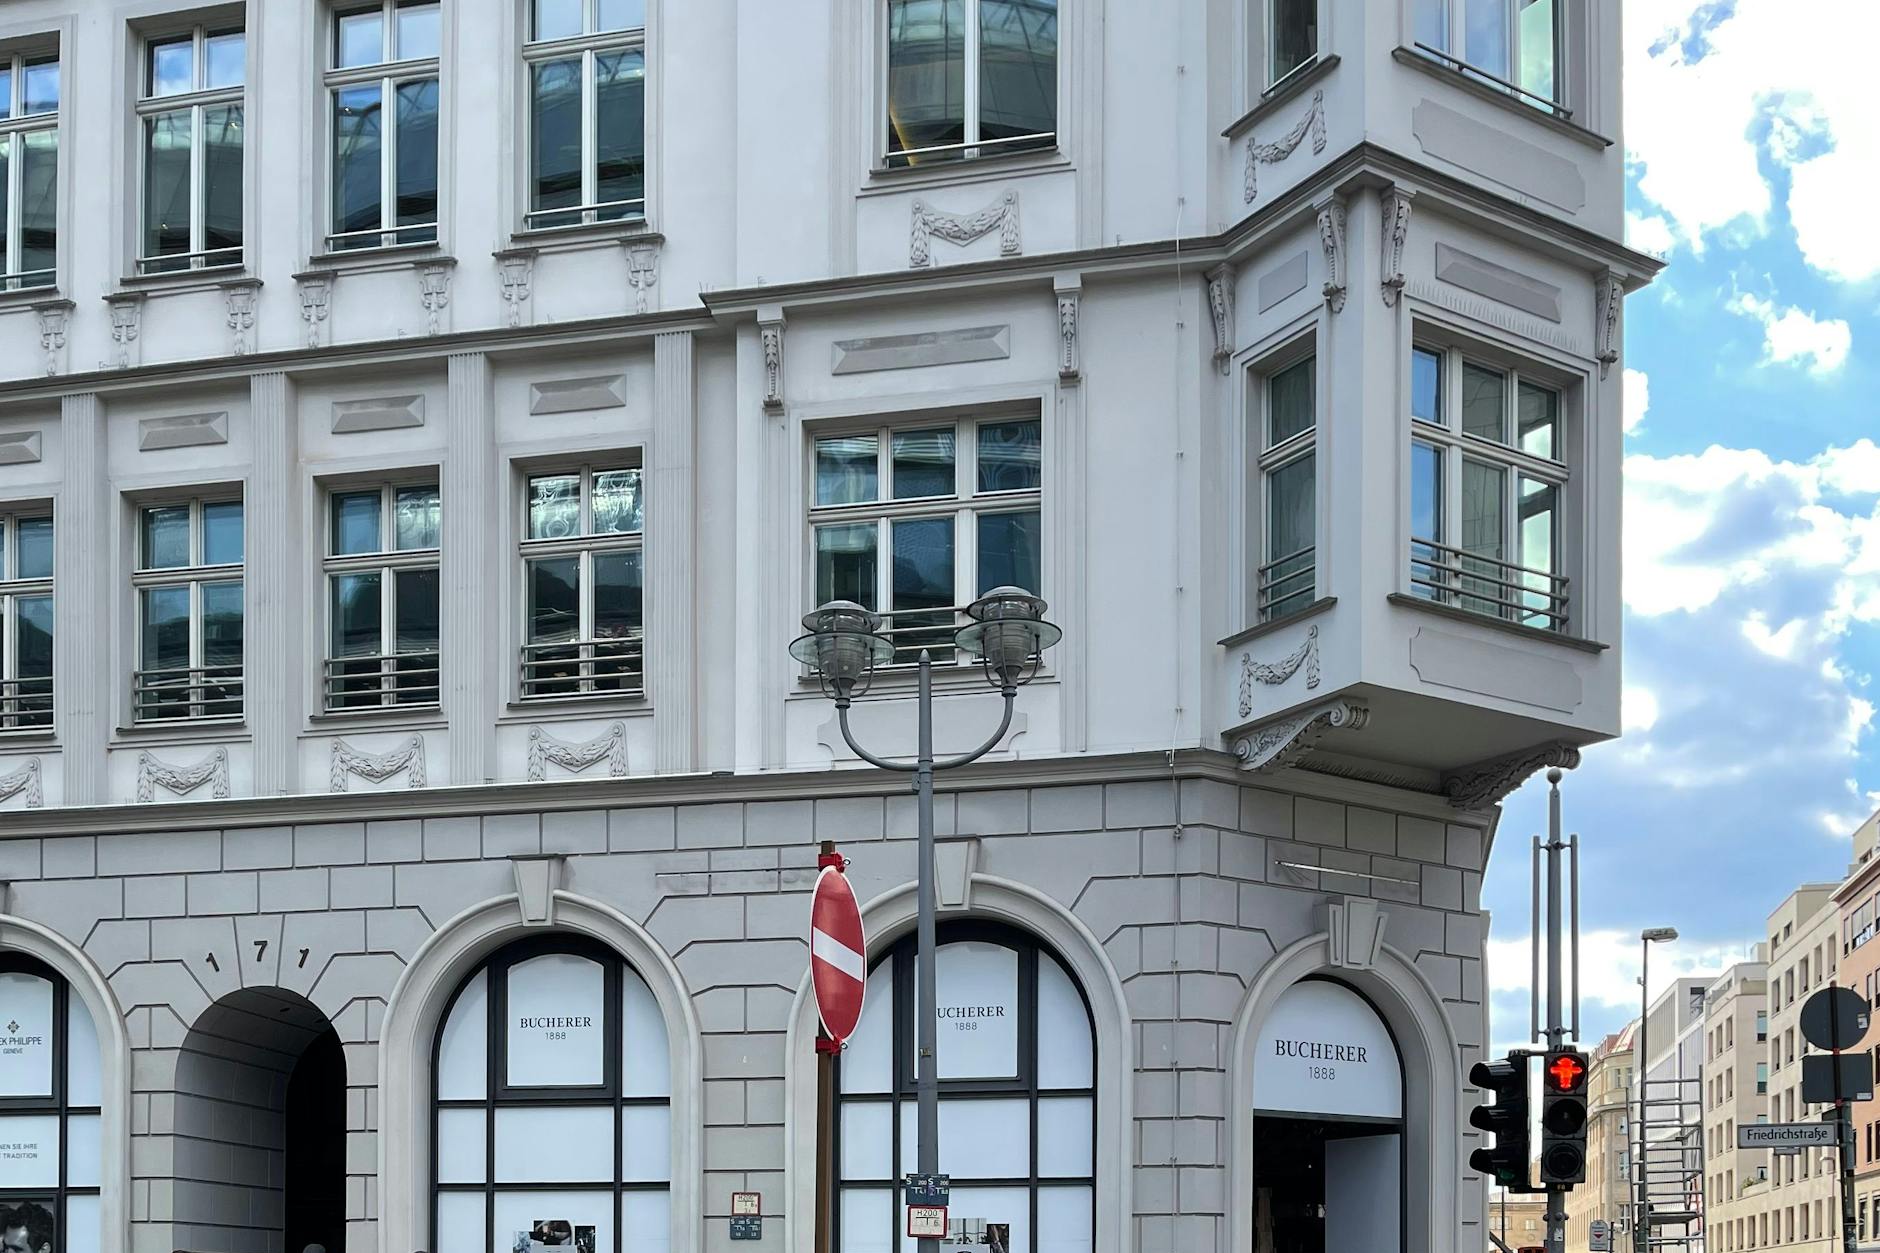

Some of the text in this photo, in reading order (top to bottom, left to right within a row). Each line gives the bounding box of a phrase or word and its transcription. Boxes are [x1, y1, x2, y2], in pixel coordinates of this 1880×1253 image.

[937, 1006, 1004, 1018] UCHERER
[520, 1017, 591, 1028] BUCHERER
[955, 1022, 977, 1030] 1888
[9, 1036, 42, 1045] PHILIPPE
[545, 1031, 567, 1040] 1888
[1275, 1039, 1368, 1063] BUCHERER
[1309, 1066, 1336, 1080] 1888
[1747, 1127, 1827, 1141] Friedrichstraße
[906, 1177, 912, 1185] S
